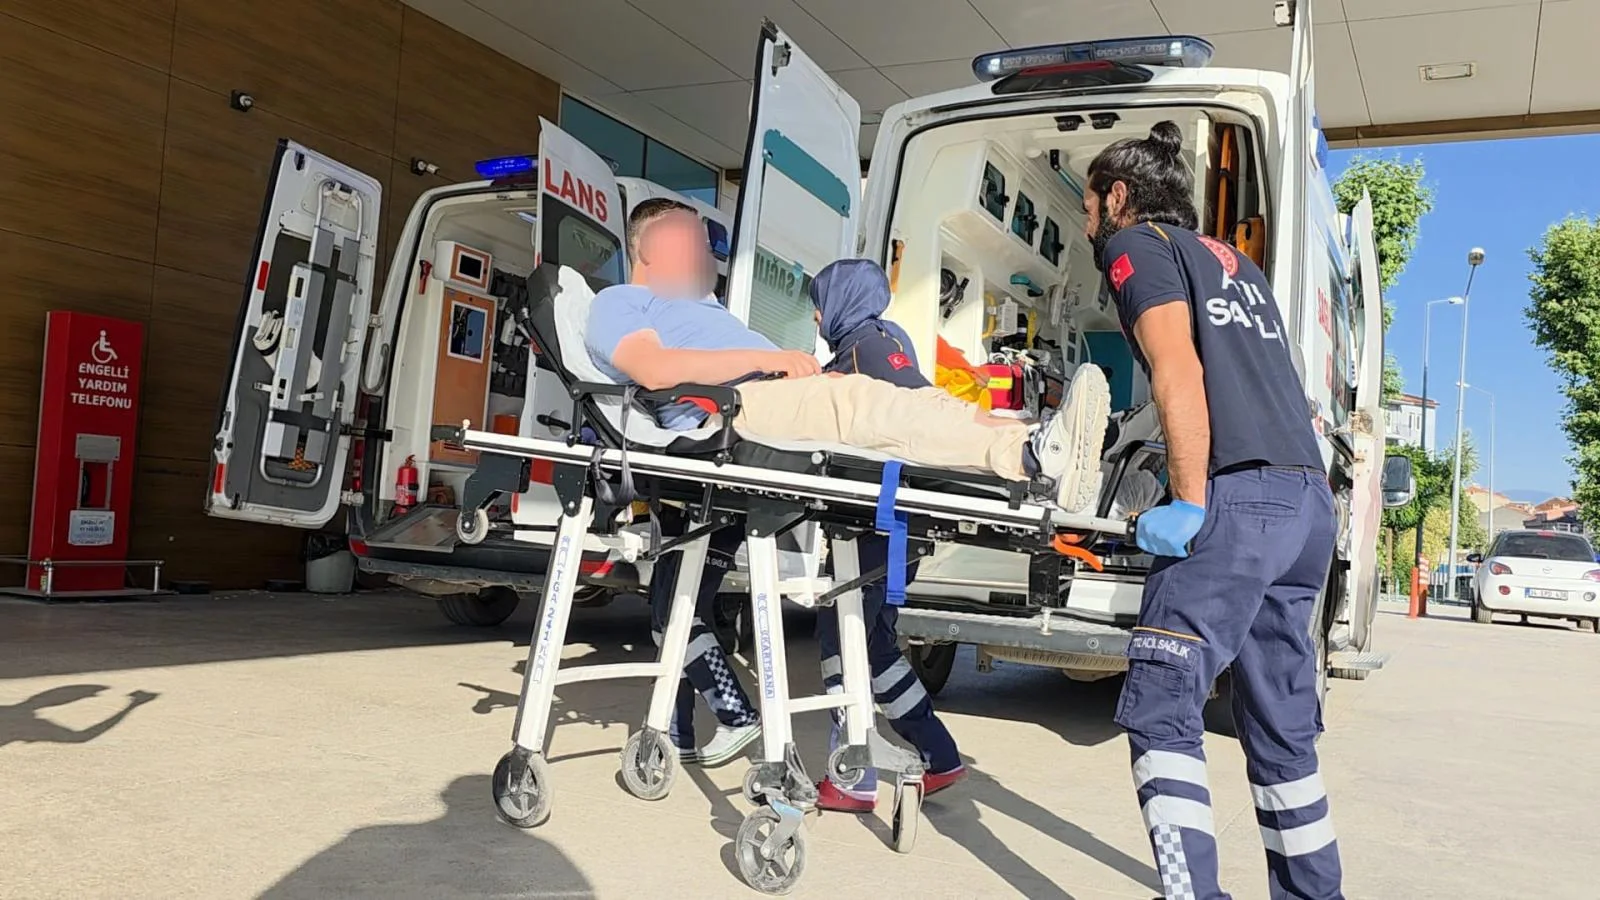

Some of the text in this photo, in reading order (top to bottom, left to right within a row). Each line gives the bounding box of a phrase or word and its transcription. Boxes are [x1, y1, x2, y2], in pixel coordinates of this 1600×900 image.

[543, 157, 609, 223] LANS
[79, 362, 129, 379] ENGELLİ
[78, 378, 127, 393] YARDIM
[71, 392, 132, 409] TELEFONU
[1157, 639, 1190, 659] SAĞLIK
